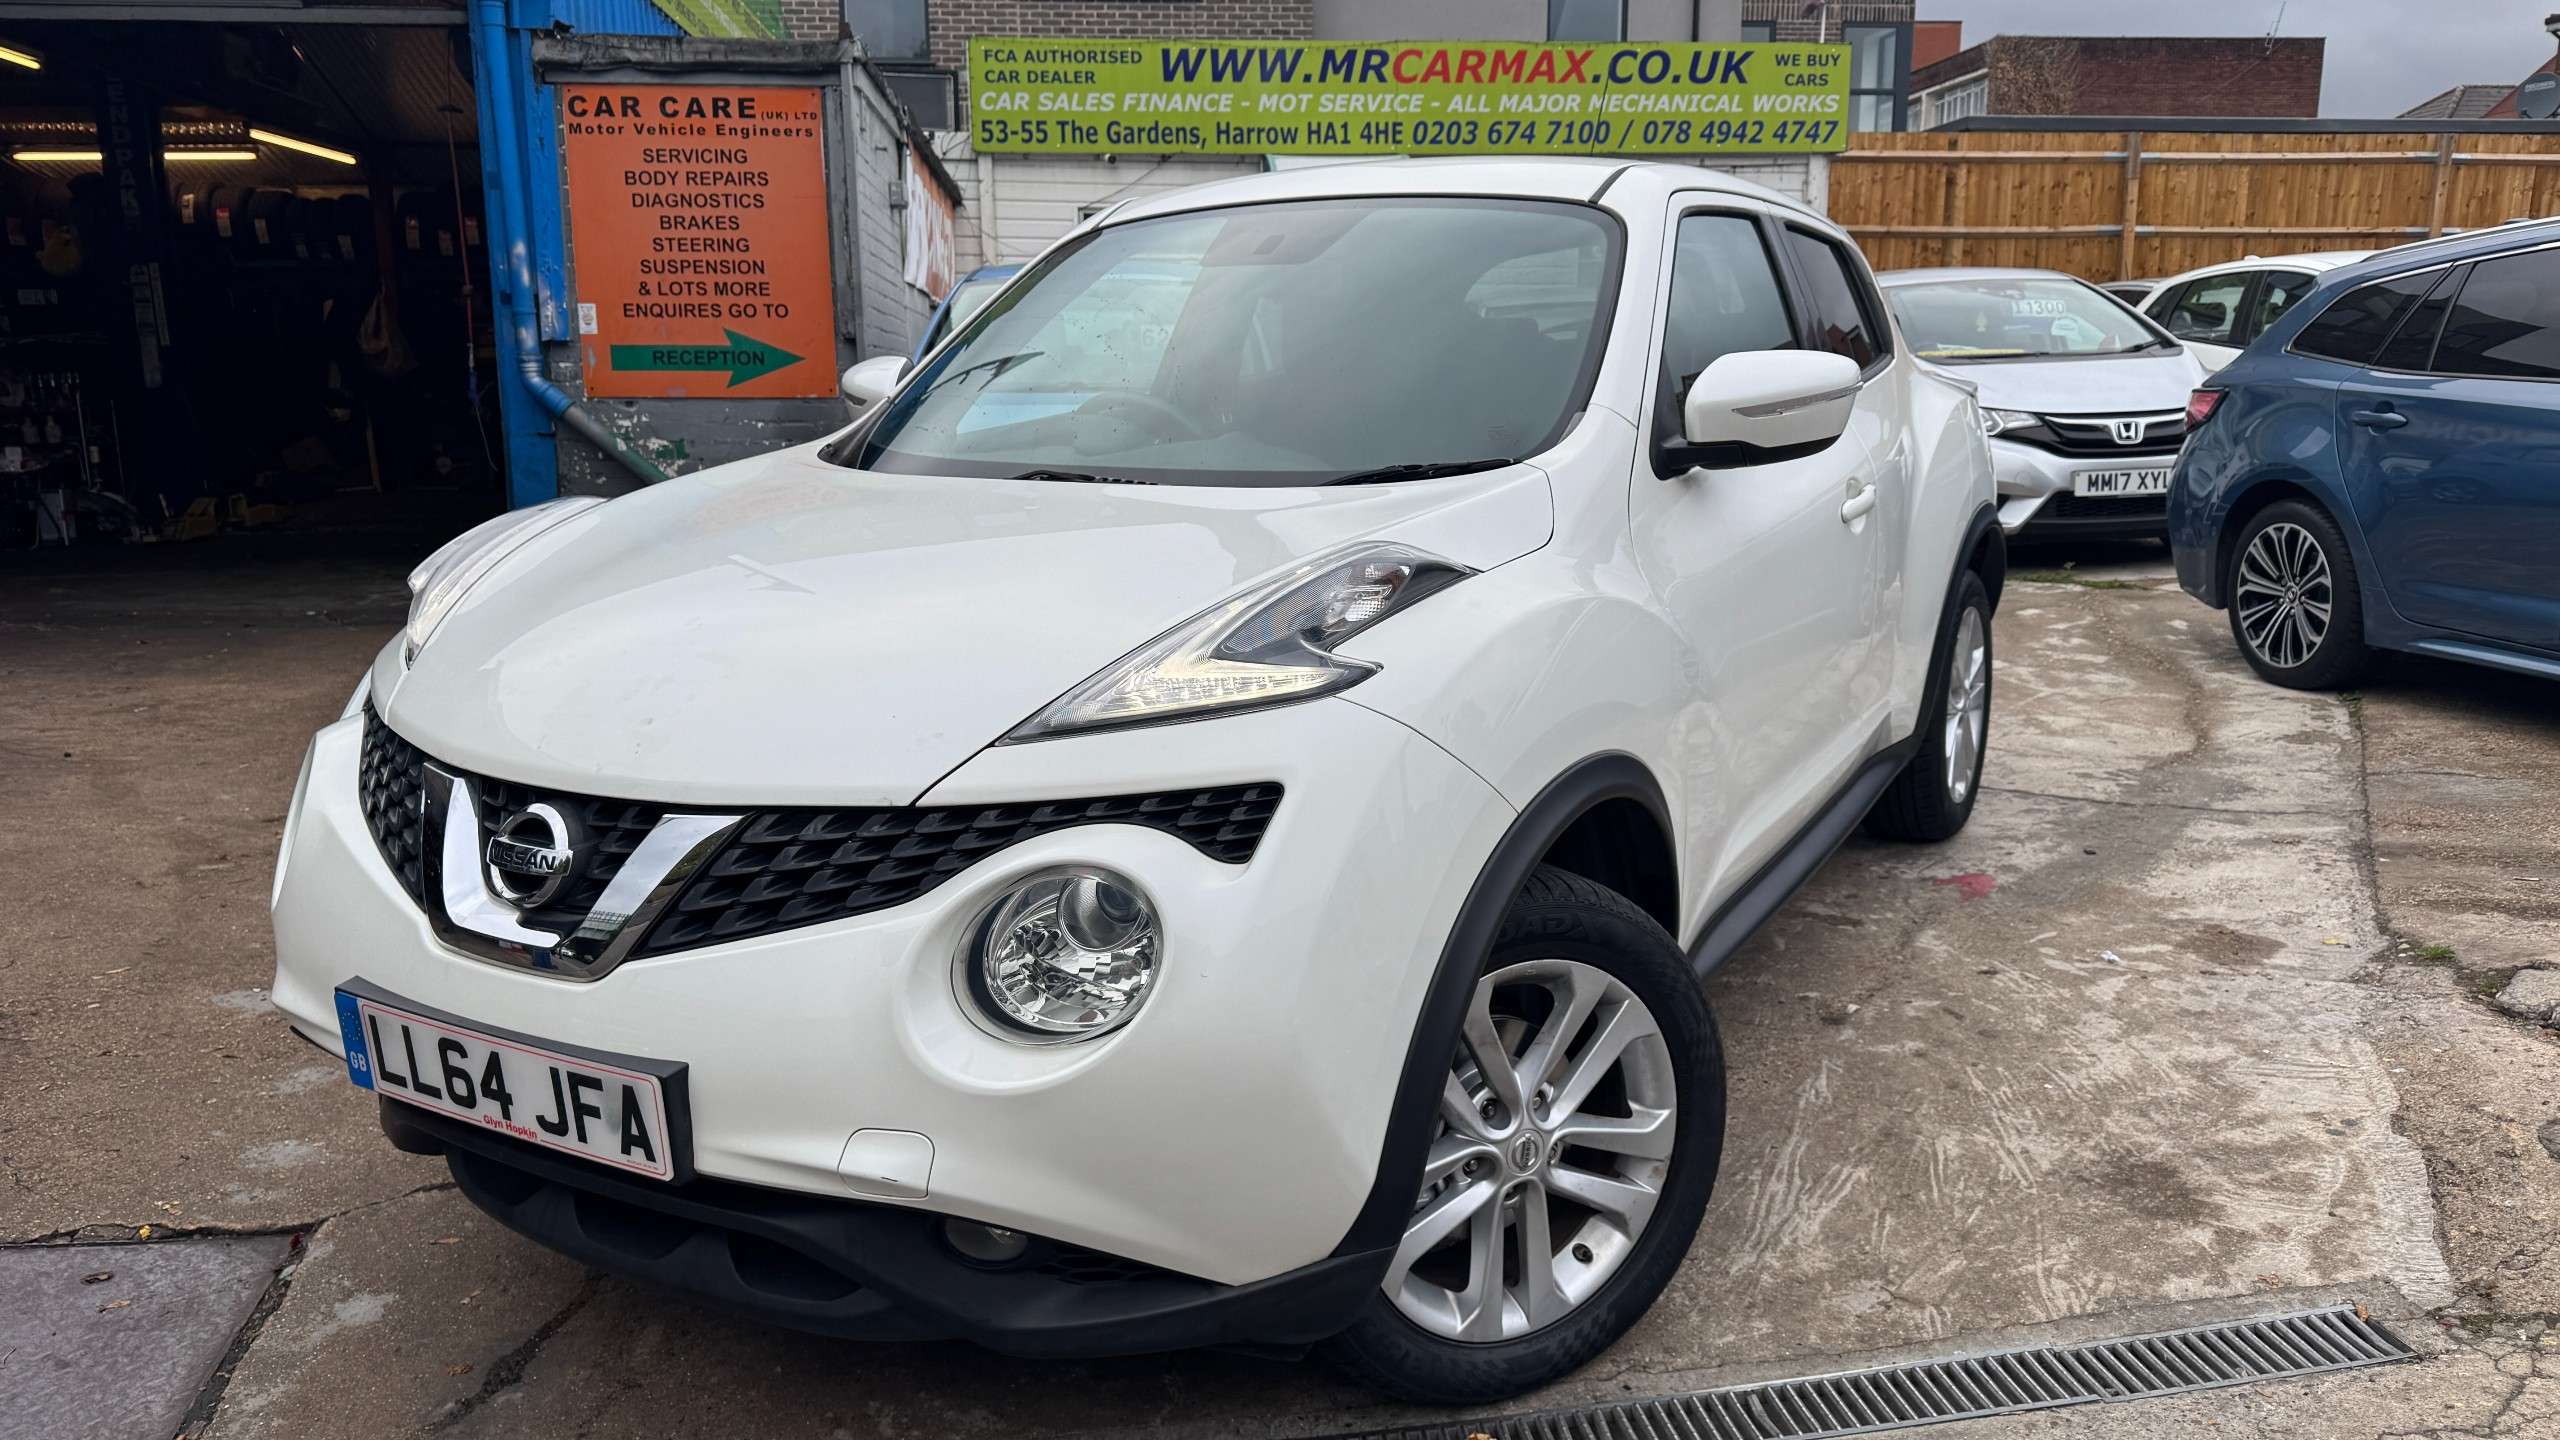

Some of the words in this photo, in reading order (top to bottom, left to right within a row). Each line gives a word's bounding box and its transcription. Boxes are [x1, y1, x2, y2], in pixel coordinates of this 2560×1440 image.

[984, 49, 1017, 64] FCA
[1024, 49, 1143, 65] AUTHORISED
[1775, 53, 1802, 67] WE
[1807, 53, 1841, 67] BUY
[1161, 47, 1754, 85] WWW.MRCARMAX.CO.UK
[984, 69, 1020, 84] CAR
[1027, 69, 1096, 85] DEALER
[1784, 73, 1829, 87] CARS
[567, 94, 642, 119] CAR
[659, 96, 757, 120] CARE
[760, 110, 790, 122] (UK)
[794, 111, 818, 121] LTD
[979, 91, 1030, 112] CAR
[1037, 92, 1115, 112] SALES
[1122, 93, 1234, 113] FINANCE
[1258, 93, 1313, 113] MOT
[1318, 93, 1425, 113] SERVICE
[1447, 94, 1491, 113] ALL
[1499, 94, 1580, 113] MAJOR
[1587, 94, 1743, 114] MECHANICAL
[1752, 94, 1840, 114] WORKS
[568, 122, 624, 136] Motor
[634, 122, 706, 137] Vehicle
[715, 123, 815, 140] Engineers
[980, 119, 1049, 145] 53-55
[1055, 119, 1099, 145] The
[1106, 119, 1207, 150] Gardens,
[1216, 120, 1299, 145] Harrow
[1307, 120, 1351, 145] HA1
[1359, 120, 1404, 145] 4HE
[1412, 120, 1478, 145] 0203
[1487, 120, 1537, 145] 674
[1543, 120, 1611, 145] 7100
[1642, 120, 1692, 145] 078
[1699, 120, 1764, 145] 4942
[1772, 120, 1840, 145] 4747
[642, 148, 748, 165] SERVICING
[624, 171, 679, 187] BODY
[686, 171, 769, 187] REPAIRS
[631, 193, 765, 209] DIAGNOSTICS
[659, 215, 740, 231] BRAKES
[652, 237, 750, 253] STEERING
[639, 259, 766, 275] SUSPENSION
[638, 281, 651, 297] &
[657, 281, 708, 297] LOTS
[714, 281, 771, 297] MORE
[623, 302, 723, 319] ENQUIRES
[728, 303, 758, 319] GO
[763, 303, 789, 319] TO
[652, 350, 766, 367] RECEPTION
[2087, 472, 2131, 492] MM17
[490, 843, 557, 873] NISSAN
[349, 1050, 368, 1073] GB
[367, 1013, 515, 1122] LL64
[535, 1065, 657, 1164] JFA
[483, 1114, 504, 1129] Glyn
[505, 1121, 539, 1139] Hopkin
